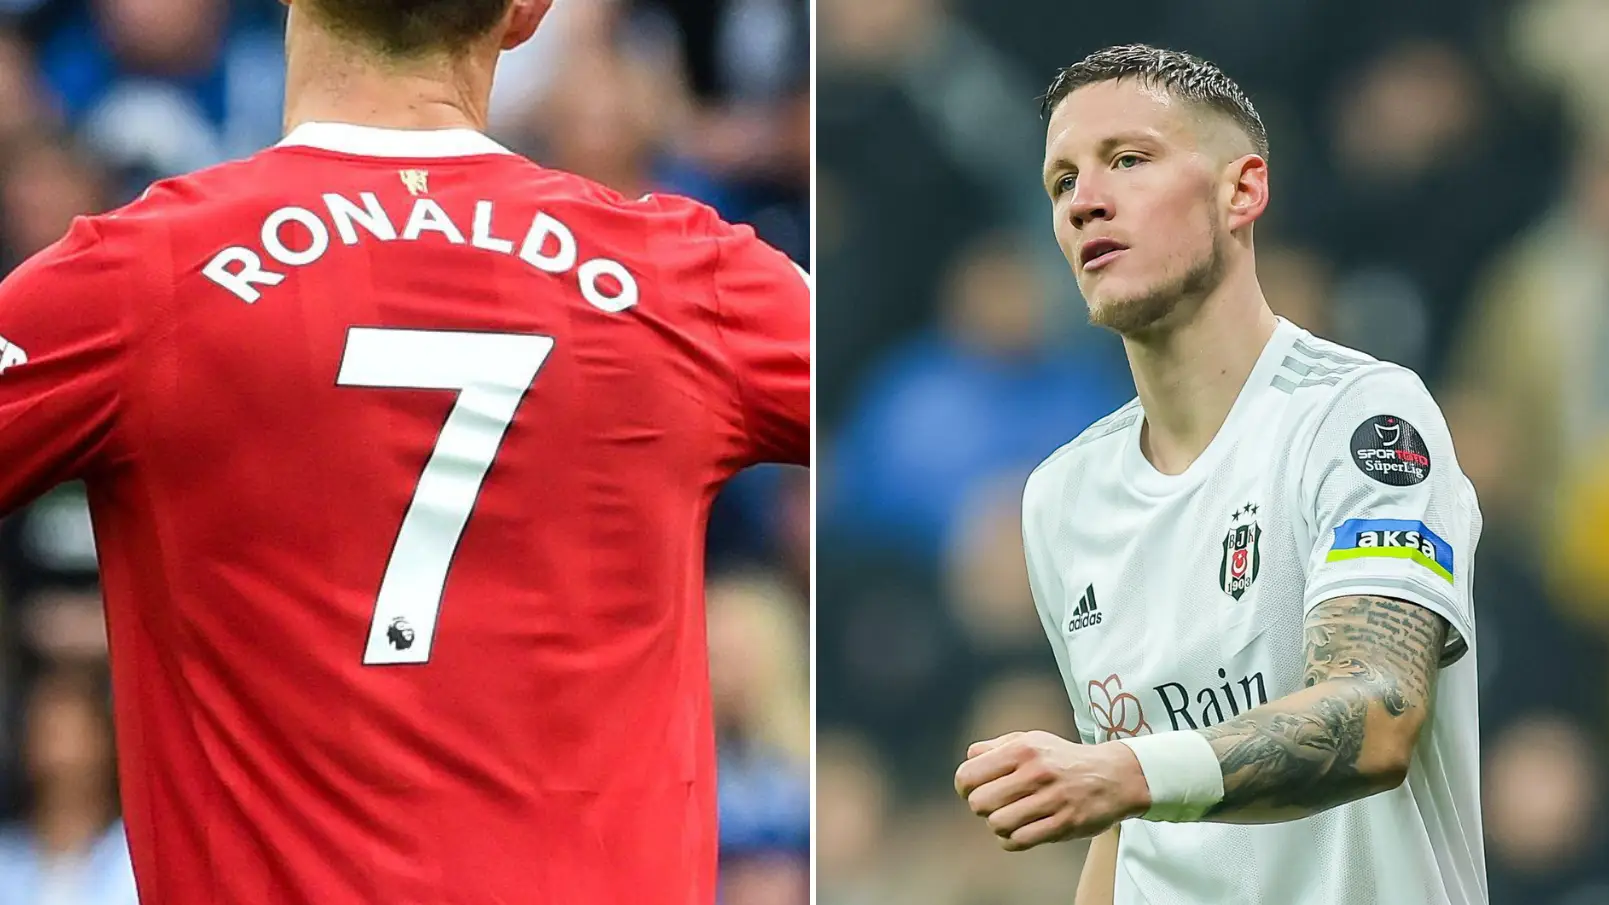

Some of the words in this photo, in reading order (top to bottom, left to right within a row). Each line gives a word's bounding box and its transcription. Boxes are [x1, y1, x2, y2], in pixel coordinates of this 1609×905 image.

[202, 192, 638, 313] RONALDO
[334, 326, 555, 665] 7
[1358, 530, 1436, 560] aksa
[1227, 576, 1251, 593] 1903
[1068, 611, 1102, 632] adidas
[1153, 667, 1268, 731] Rain
